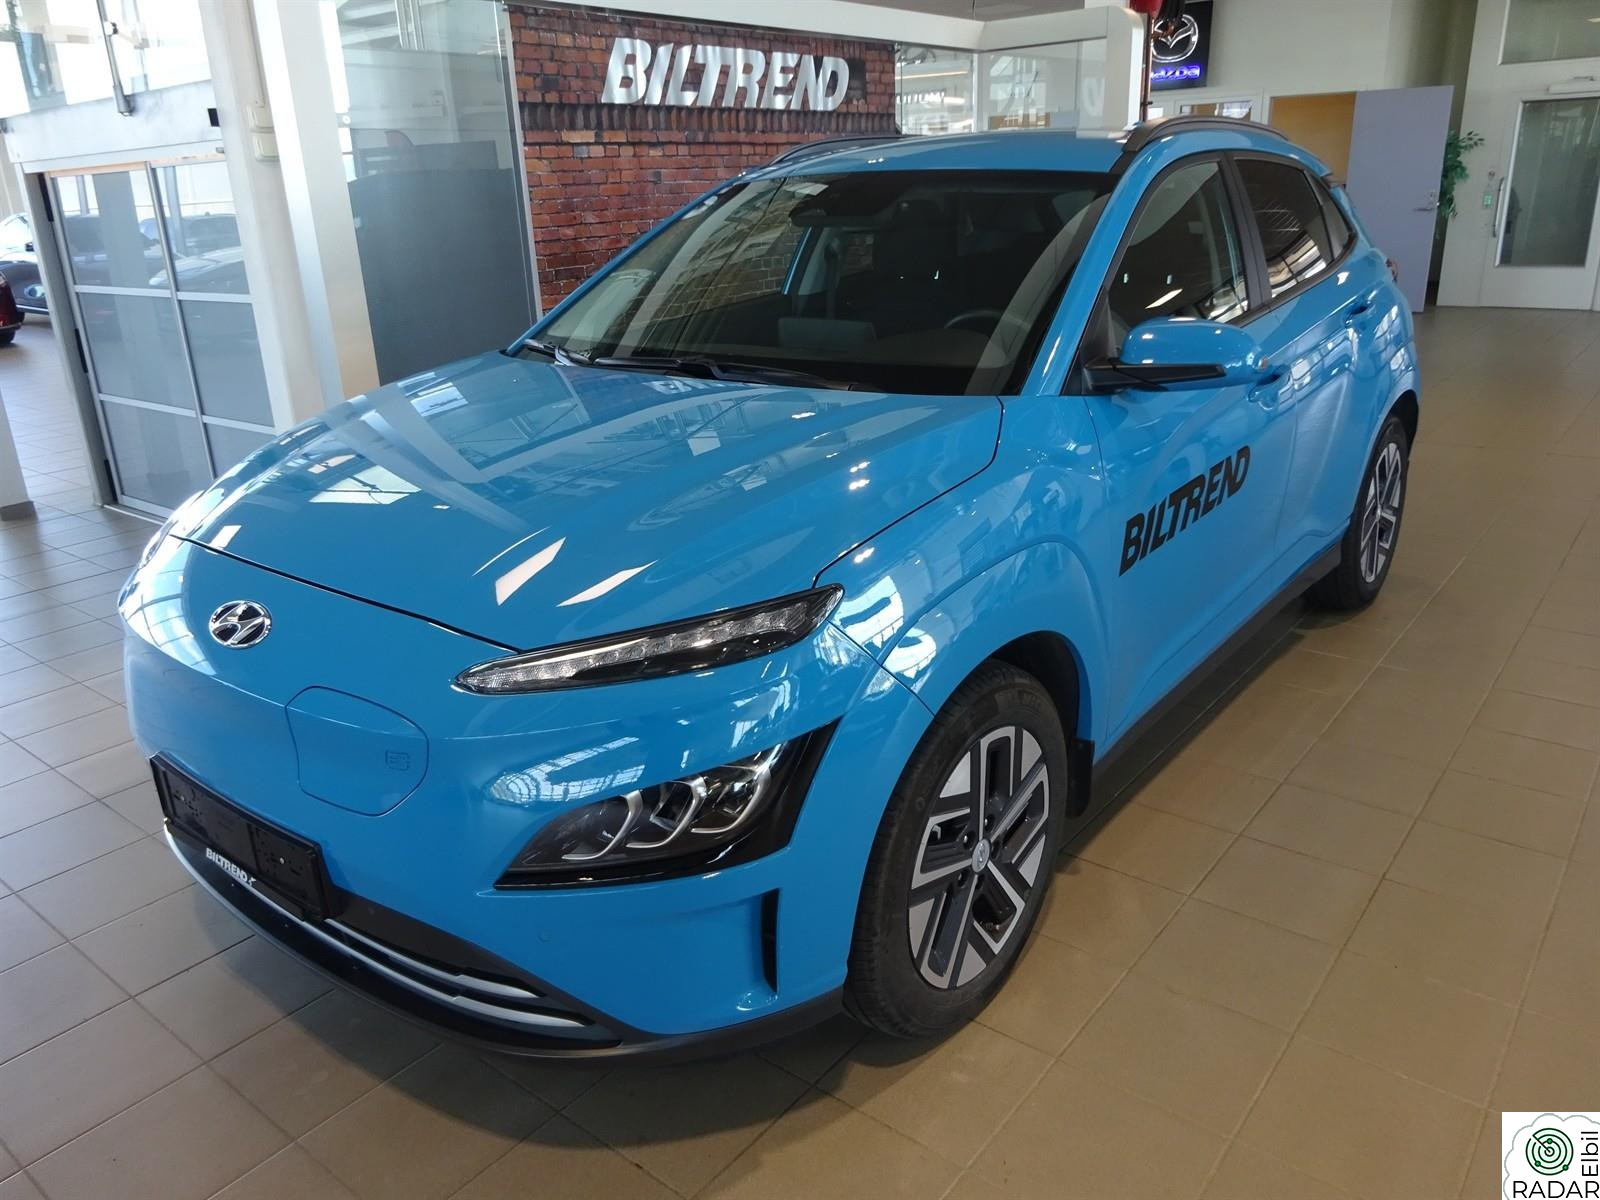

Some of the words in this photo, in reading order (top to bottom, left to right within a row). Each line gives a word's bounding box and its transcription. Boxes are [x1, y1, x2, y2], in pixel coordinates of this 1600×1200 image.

[601, 37, 850, 112] BILTREND
[1119, 445, 1250, 577] BILTREND
[206, 847, 248, 882] BILTREND
